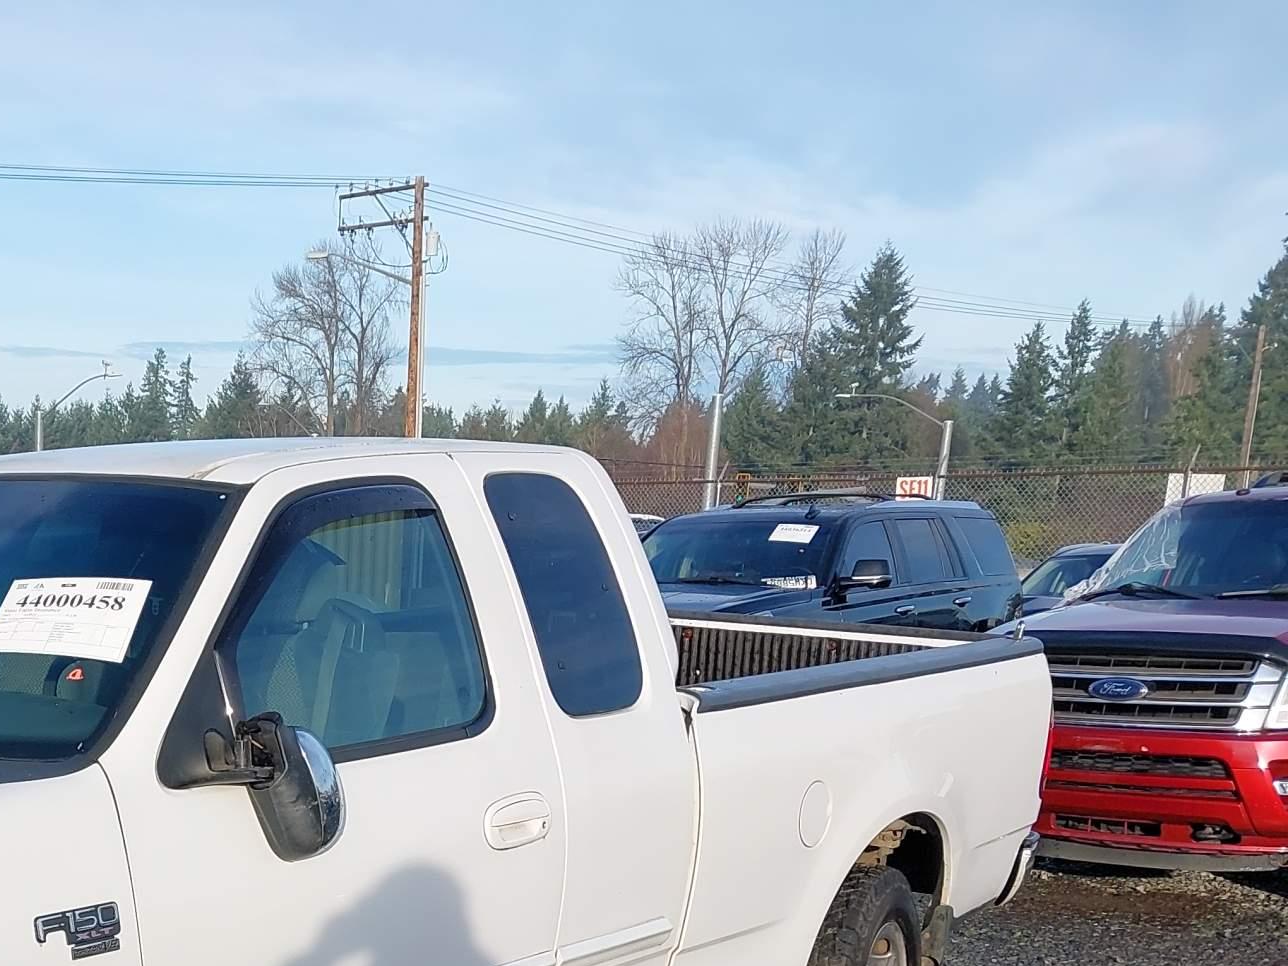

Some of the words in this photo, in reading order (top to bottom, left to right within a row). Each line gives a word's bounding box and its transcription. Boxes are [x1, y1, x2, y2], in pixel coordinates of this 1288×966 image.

[15, 593, 126, 611] 44000458
[1099, 682, 1133, 696] Ford
[75, 926, 114, 941] XLT
